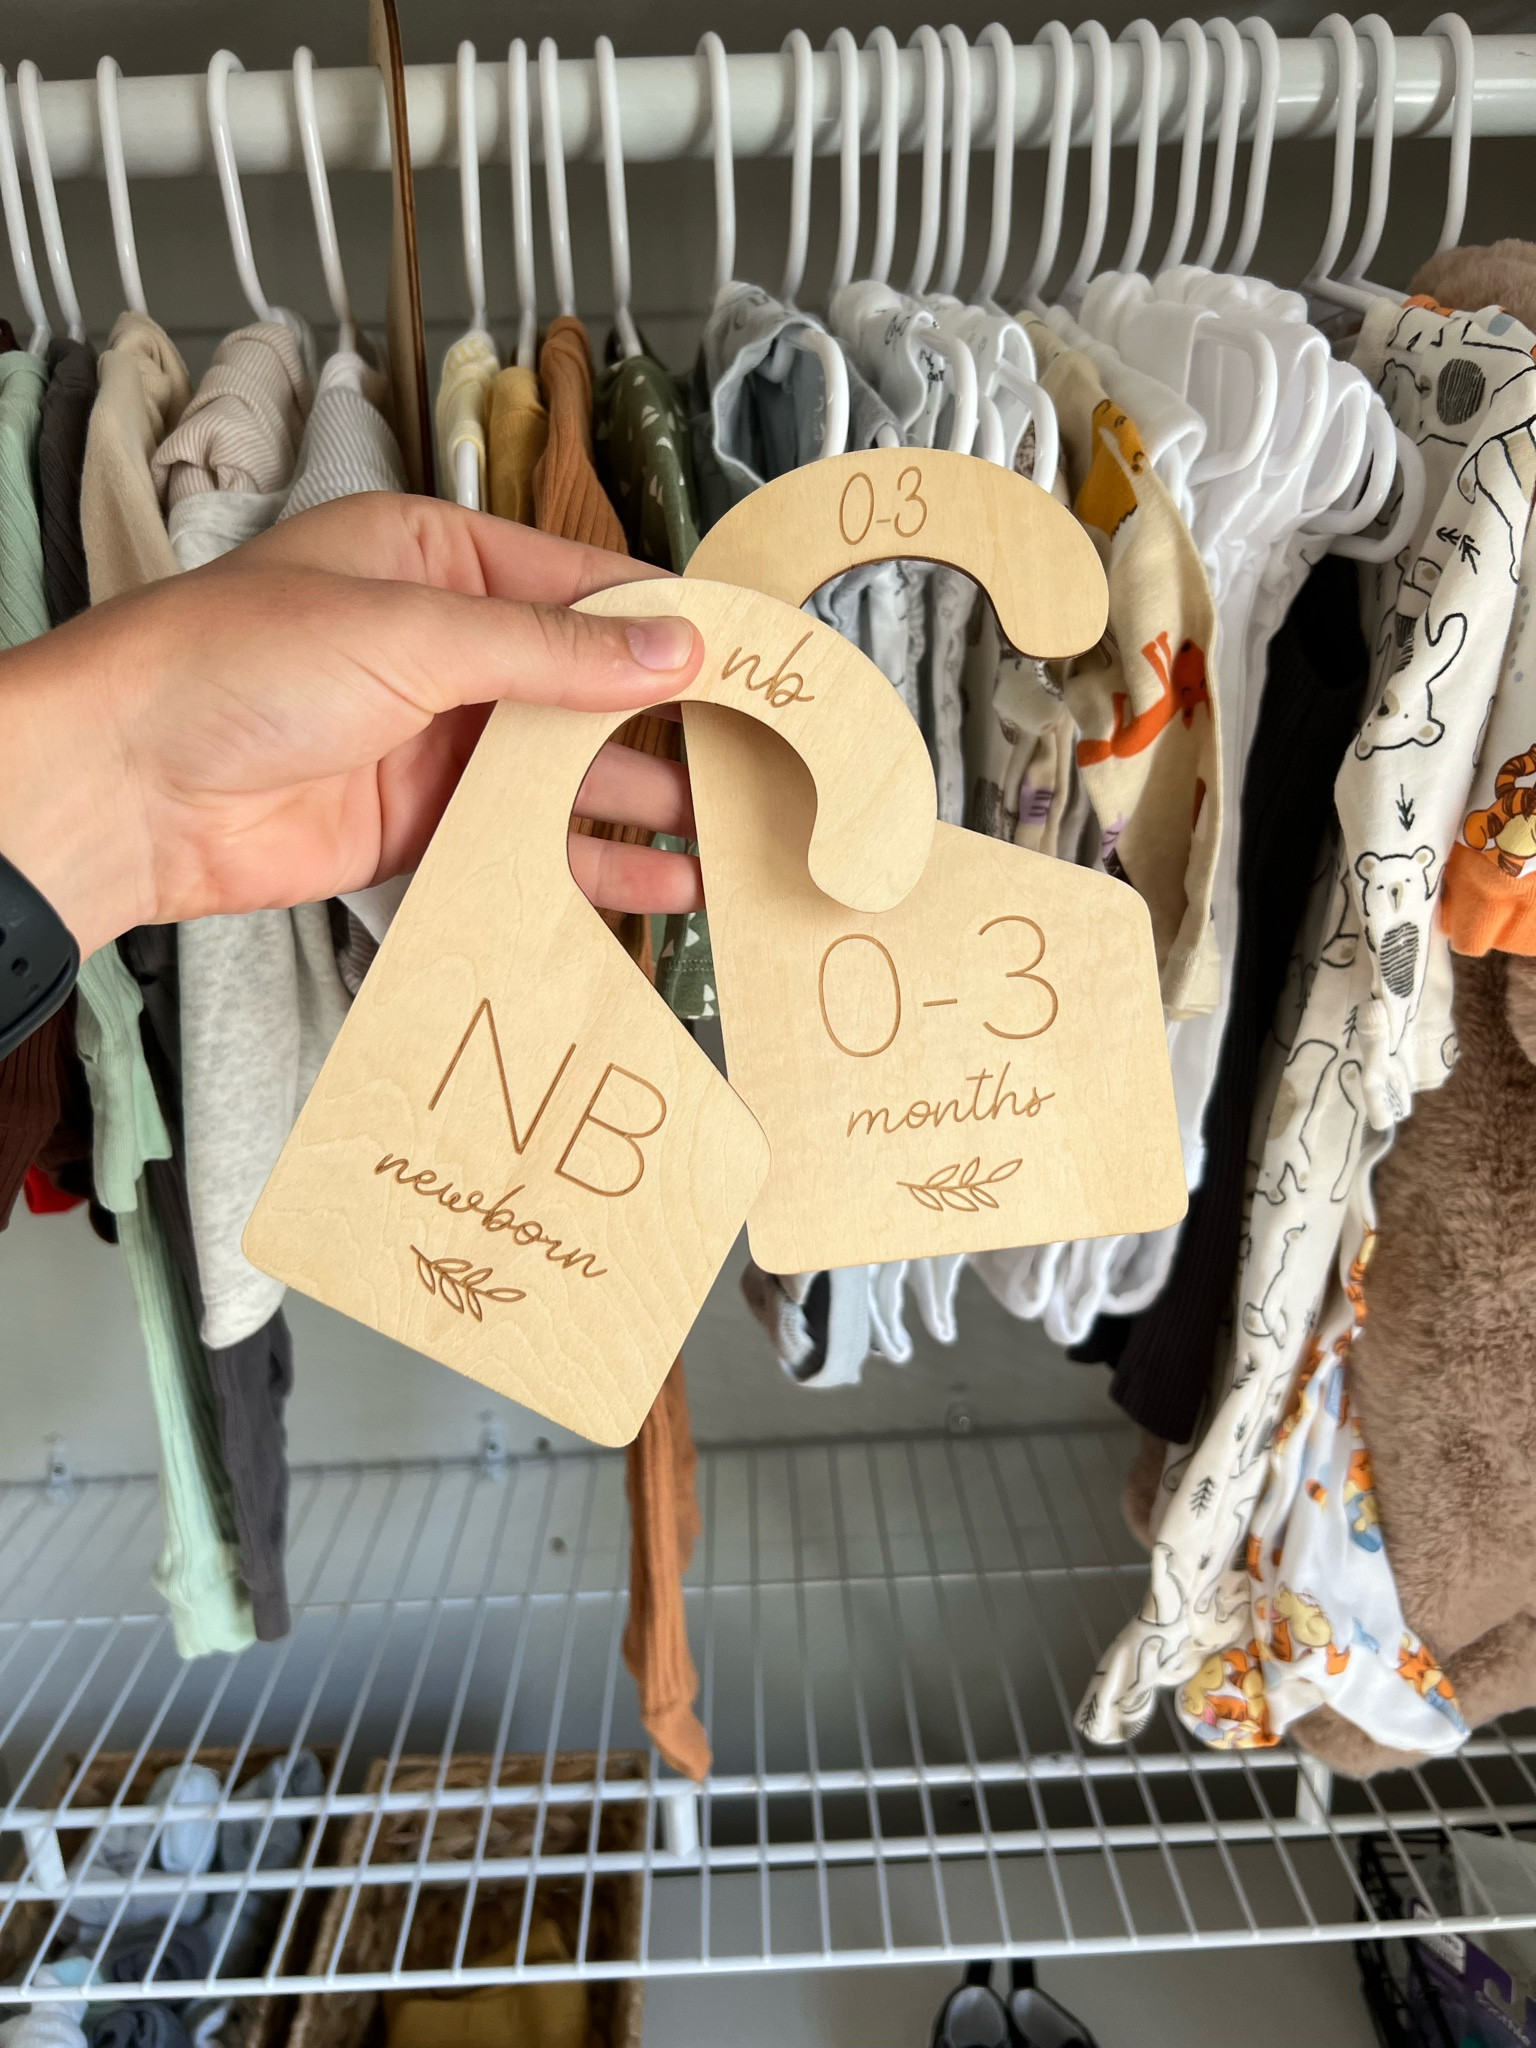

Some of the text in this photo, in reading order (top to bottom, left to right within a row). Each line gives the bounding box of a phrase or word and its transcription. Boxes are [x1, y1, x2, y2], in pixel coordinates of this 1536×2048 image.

[839, 466, 927, 545] 0-3
[721, 631, 815, 709] nb
[819, 915, 1058, 1058] 0-3
[428, 997, 667, 1197] NB
[846, 1061, 1055, 1137] months
[374, 1153, 608, 1278] newborn
